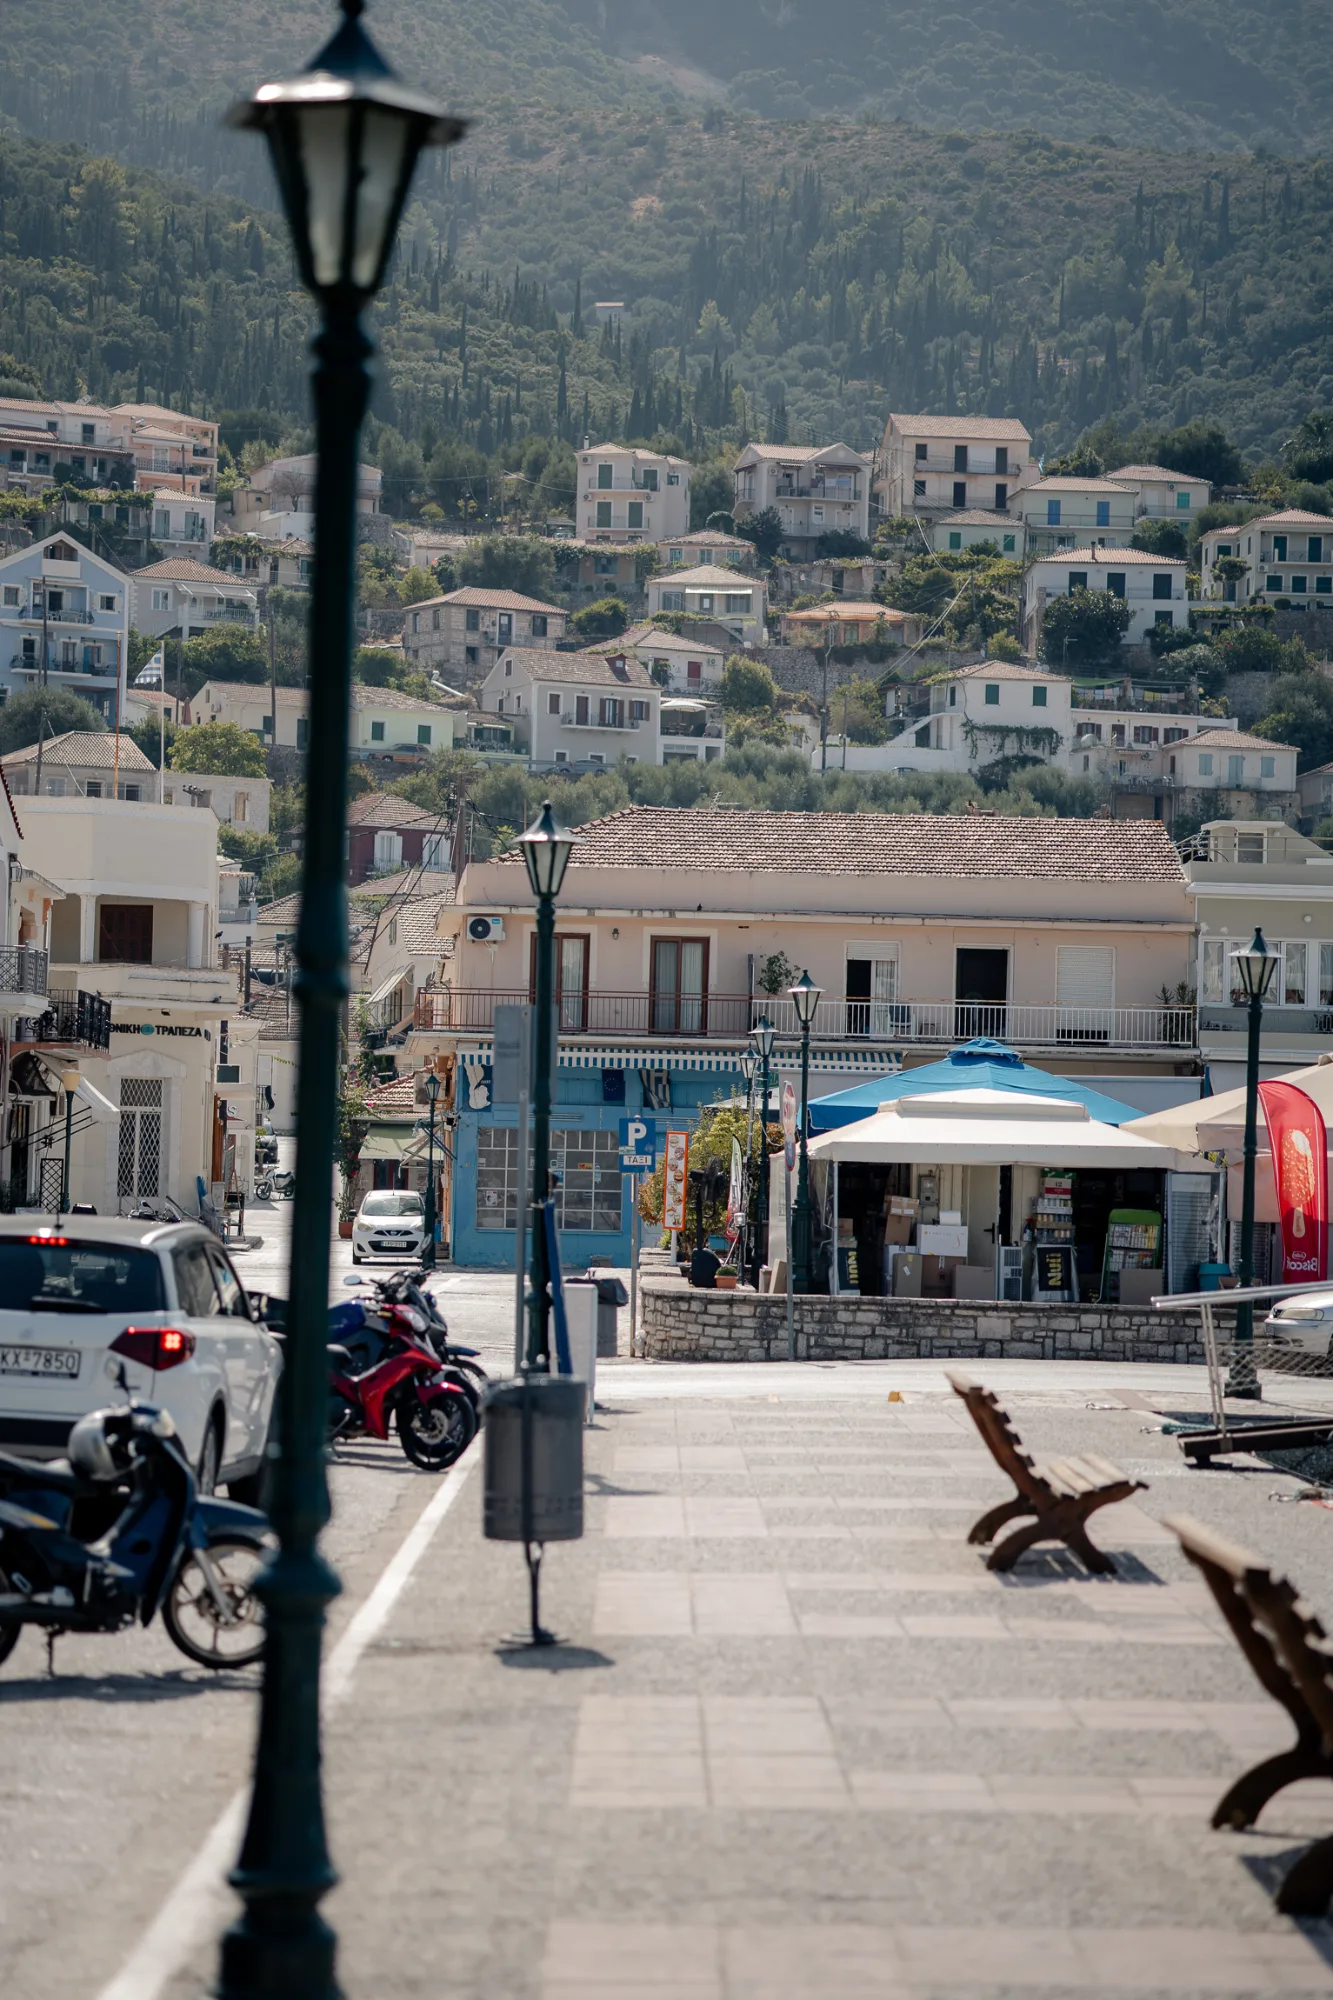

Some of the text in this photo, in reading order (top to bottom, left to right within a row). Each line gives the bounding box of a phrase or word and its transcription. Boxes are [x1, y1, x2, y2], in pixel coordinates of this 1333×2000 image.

[108, 1023, 140, 1034] ΘΝΙΚΗ
[155, 1025, 202, 1037] ΤΡΑΠΕΖΑ
[628, 1122, 647, 1147] P
[627, 1156, 648, 1164] ΤΑΞΙ
[1046, 1253, 1062, 1286] Nuii
